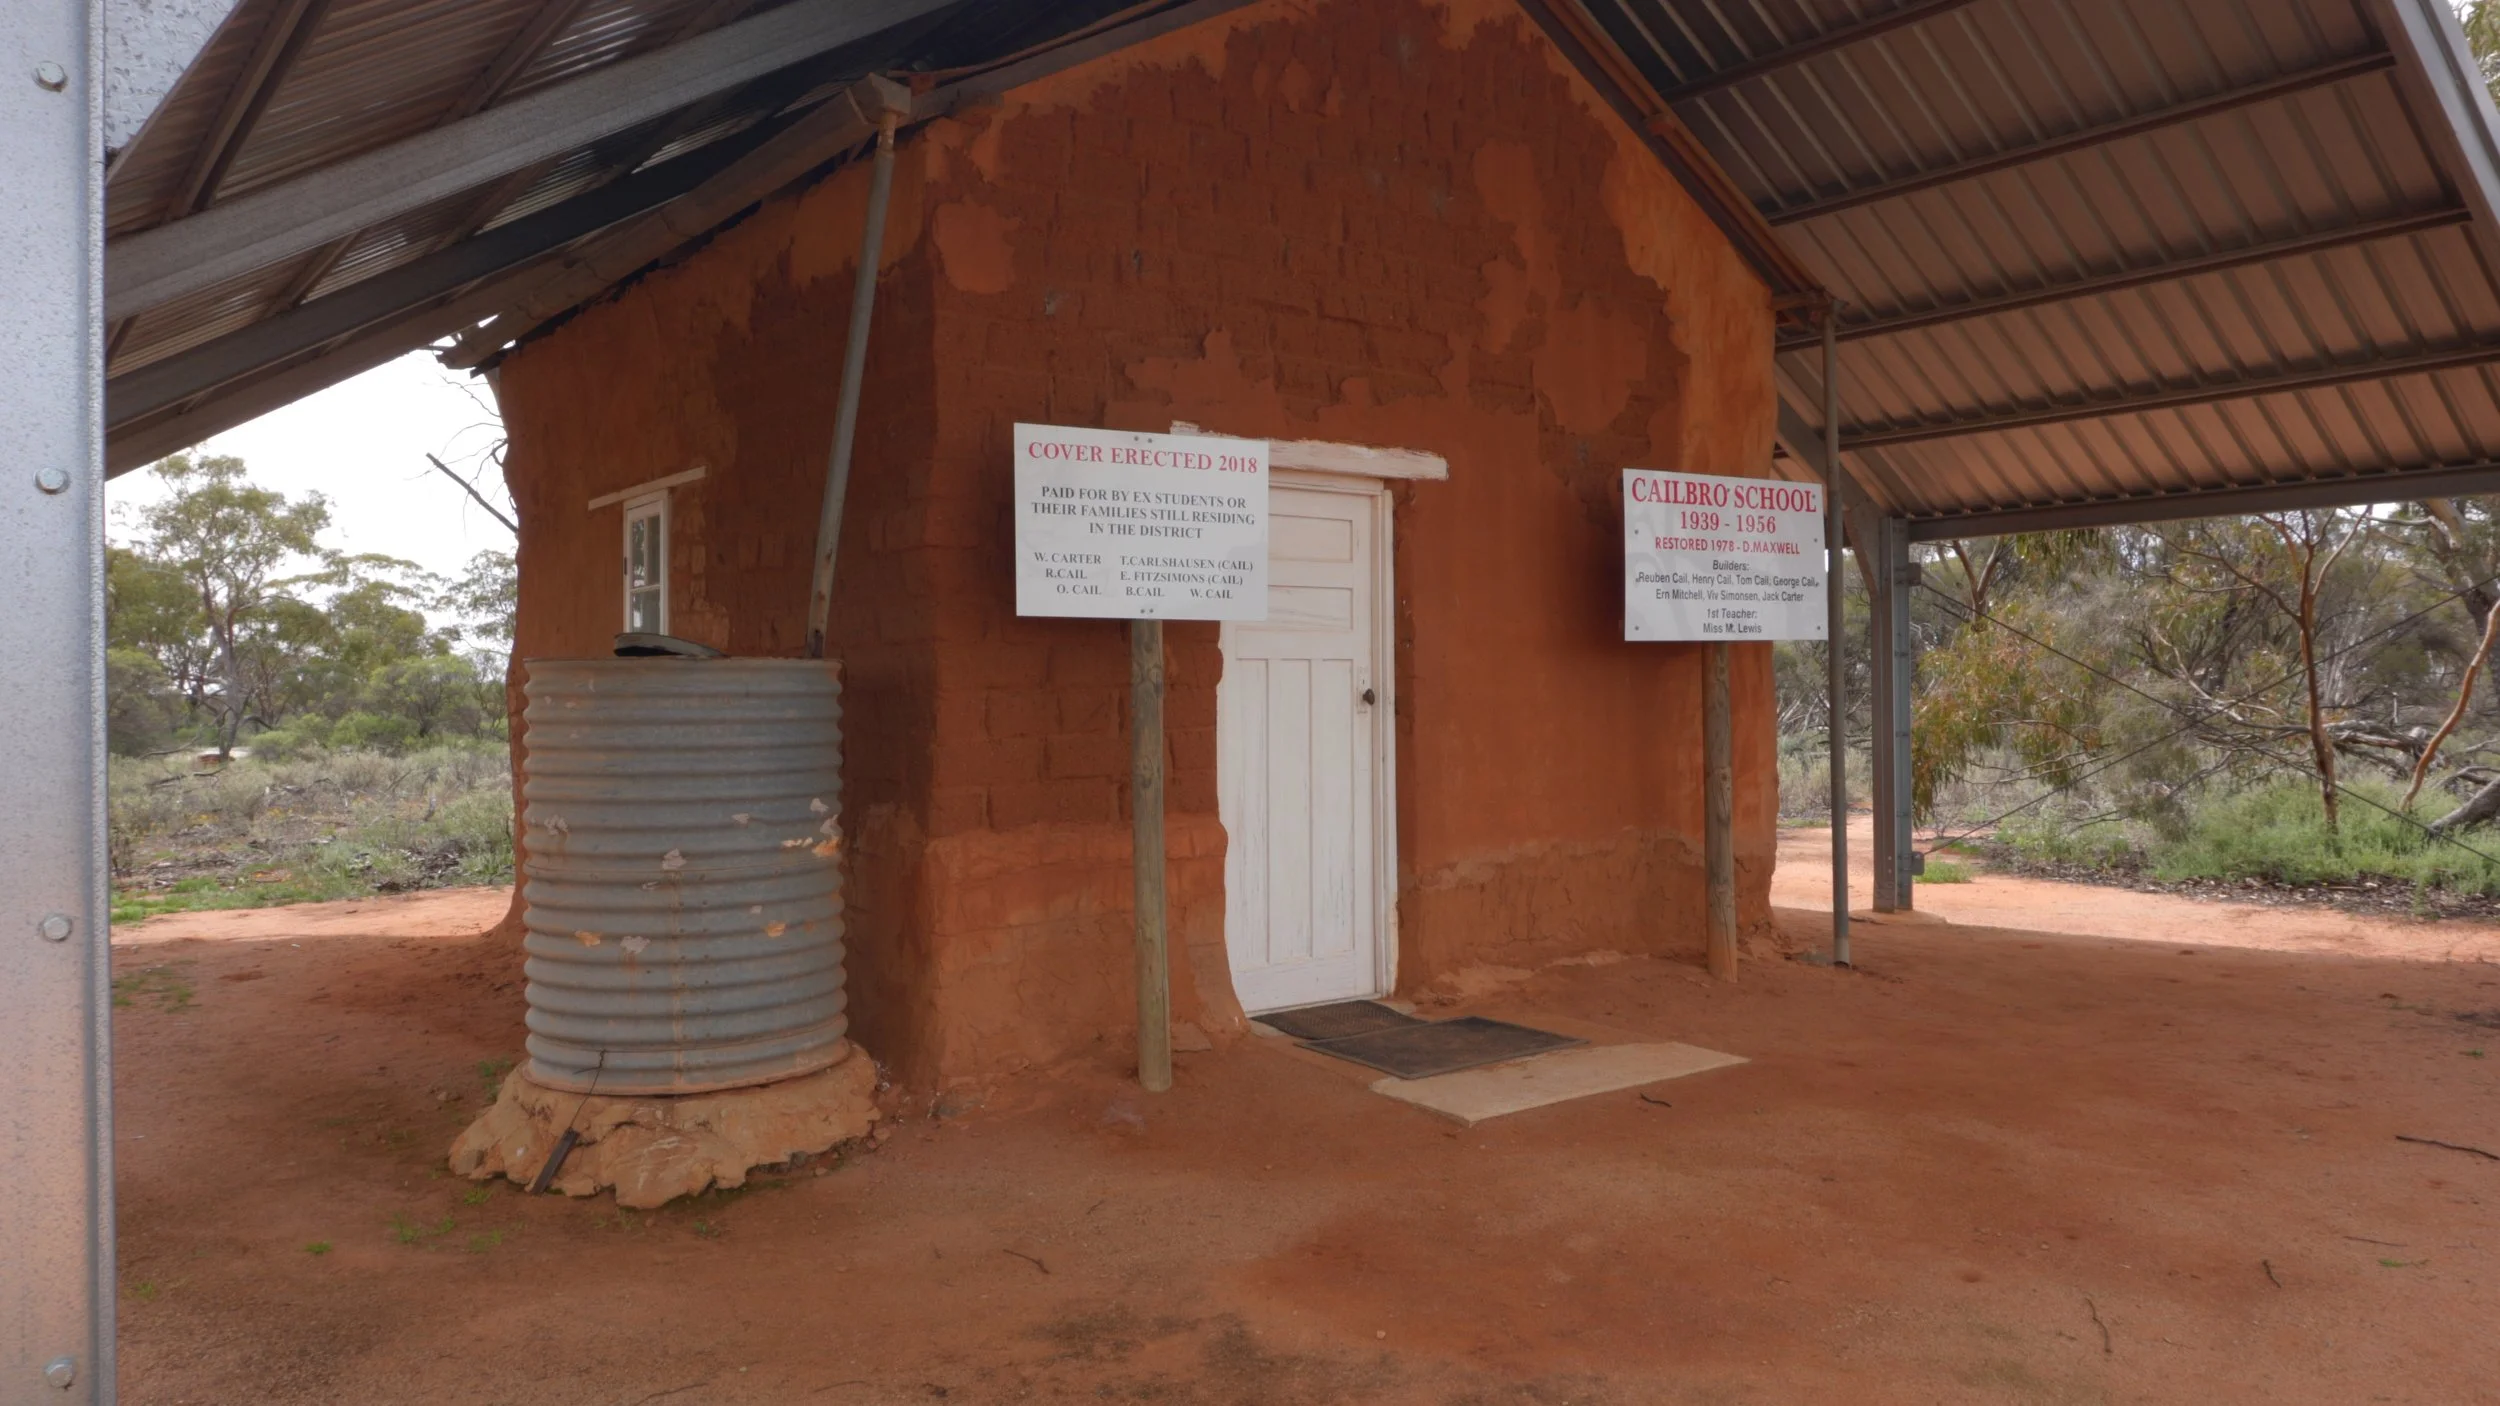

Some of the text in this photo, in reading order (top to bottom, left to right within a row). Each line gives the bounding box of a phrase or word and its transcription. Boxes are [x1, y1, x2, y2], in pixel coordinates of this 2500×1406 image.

[1028, 441, 1258, 474] COVER ERECTED 2018
[1041, 486, 1247, 509] PAID FOR BY EX STUDENTS OR
[1631, 477, 1817, 513] CAILBRO SCHOOL
[1031, 502, 1256, 525] THEIR FAMILIES STILL RESIDING
[1680, 511, 1720, 531] 1939
[1736, 514, 1776, 534] 1956
[1089, 522, 1204, 540] IN THE DISTRICT
[1655, 536, 1708, 552] RESTORED
[1711, 539, 1735, 553] 1978
[1742, 540, 1800, 555] D.MAXWELL
[1034, 552, 1102, 565] W. CARTER
[1712, 559, 1750, 571] Builders:
[1217, 560, 1254, 573] (CAIL)
[1045, 568, 1088, 580] R.CAIL
[1120, 571, 1244, 586] E. FITZSIMONS (CAIL)
[1638, 571, 1670, 583] Reuben
[1692, 573, 1715, 587] Henry
[1736, 574, 1753, 586] Tom
[1773, 576, 1800, 589] George
[1056, 584, 1102, 596] O. CAIL
[1125, 586, 1166, 597] B.CAIL
[1189, 588, 1234, 600] W. CAIL
[1656, 588, 1805, 602] Ern Mitchell, Viv Simonsen, Jack Carter
[1707, 608, 1758, 619] 1st Teacher:
[1703, 622, 1723, 634] Miss
[1738, 622, 1762, 634] Lewis
